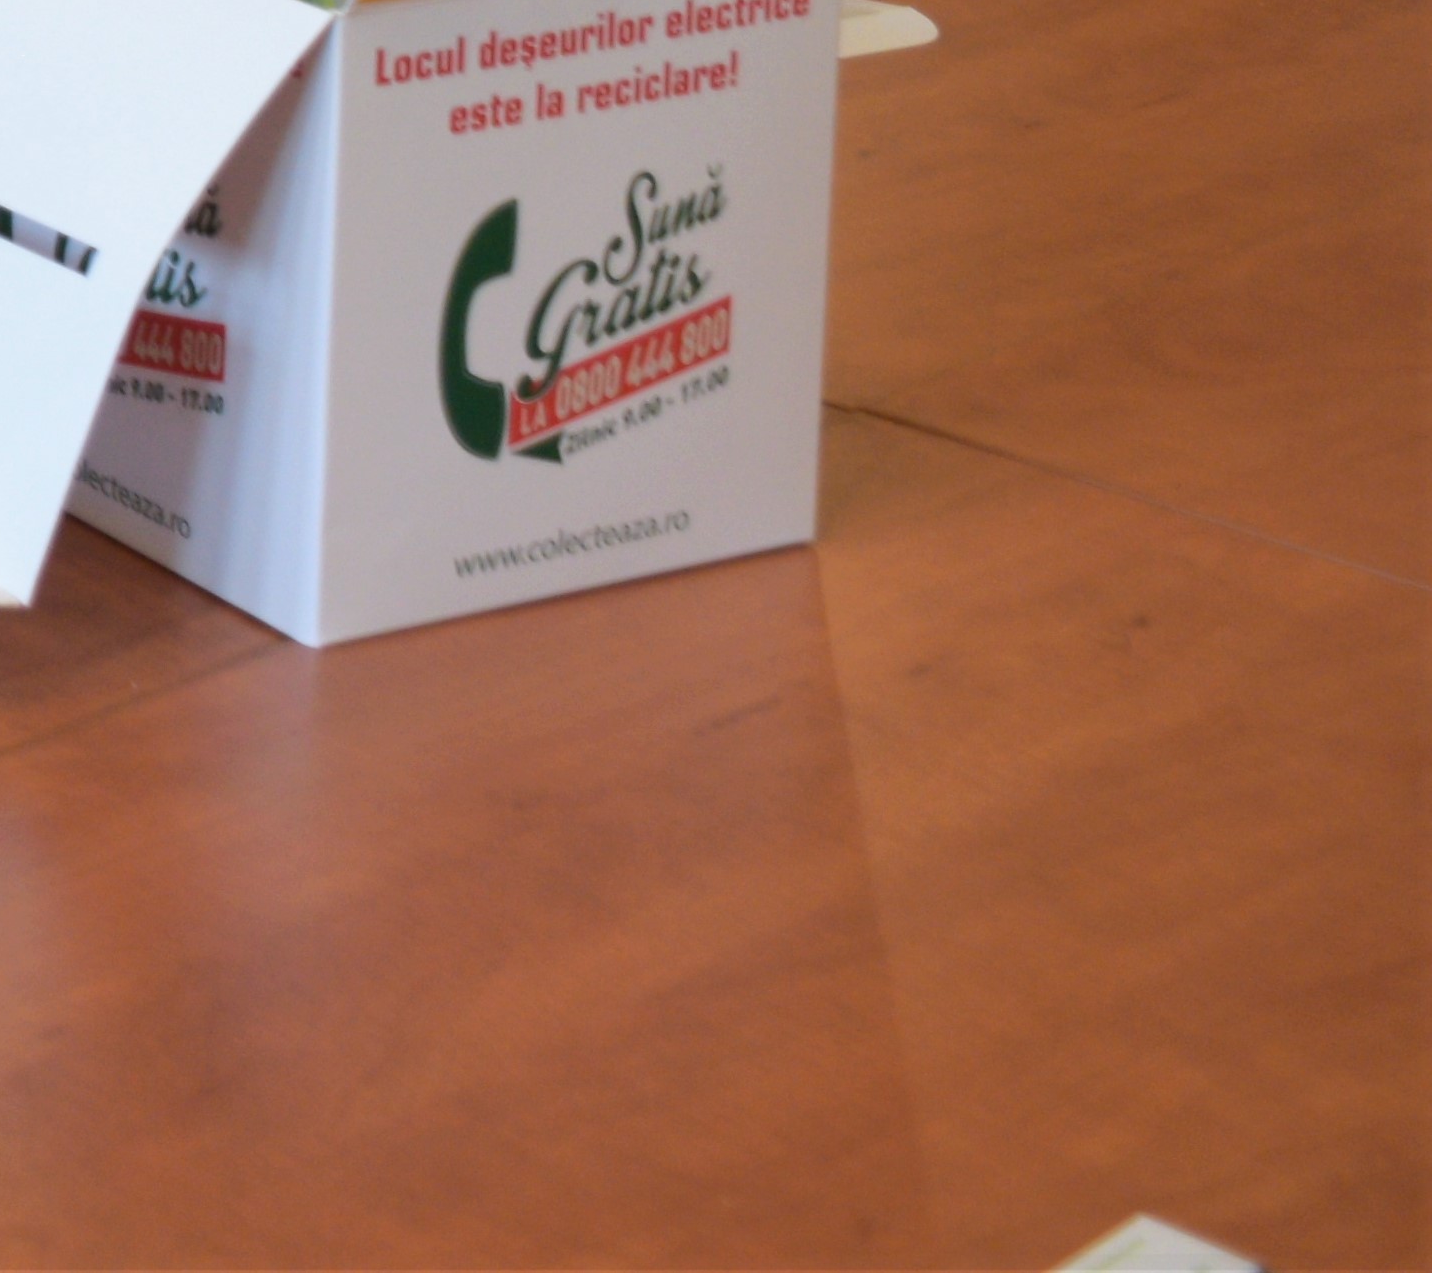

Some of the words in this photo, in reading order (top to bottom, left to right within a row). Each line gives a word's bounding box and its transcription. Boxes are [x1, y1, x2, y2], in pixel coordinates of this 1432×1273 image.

[373, 36, 466, 86] Locul
[449, 94, 525, 136] este
[536, 83, 566, 121] la
[577, 50, 741, 114] reciclare!
[604, 162, 727, 286] Sună
[516, 248, 711, 402] Gratis
[519, 400, 548, 437] LA
[555, 354, 623, 420] 0800
[625, 330, 676, 388] 444
[679, 306, 729, 367] 800
